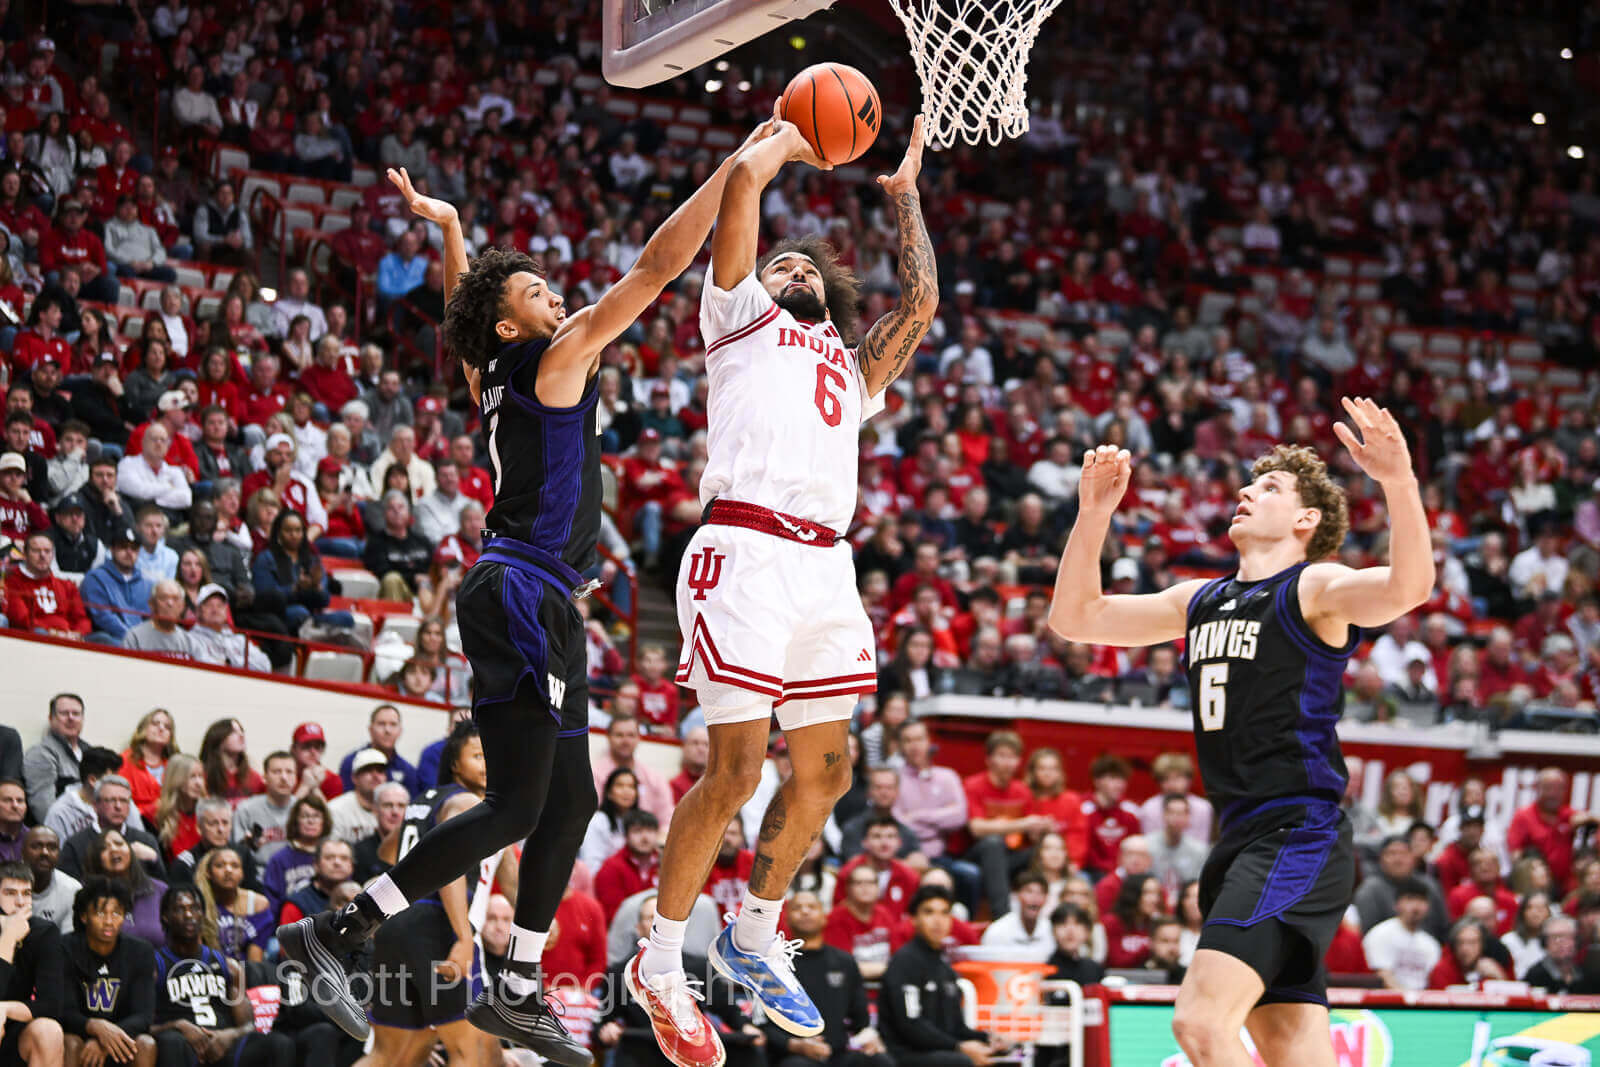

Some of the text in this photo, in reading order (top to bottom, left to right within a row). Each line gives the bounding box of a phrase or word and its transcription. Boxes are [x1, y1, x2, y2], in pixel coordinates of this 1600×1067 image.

[778, 327, 853, 376] INDIA
[815, 362, 847, 428] 6
[547, 672, 566, 710] W
[1199, 662, 1230, 732] 6
[82, 977, 121, 1012] W
[167, 973, 226, 1003] DAWGS
[1009, 974, 1035, 1001] G
[190, 995, 217, 1027] 5
